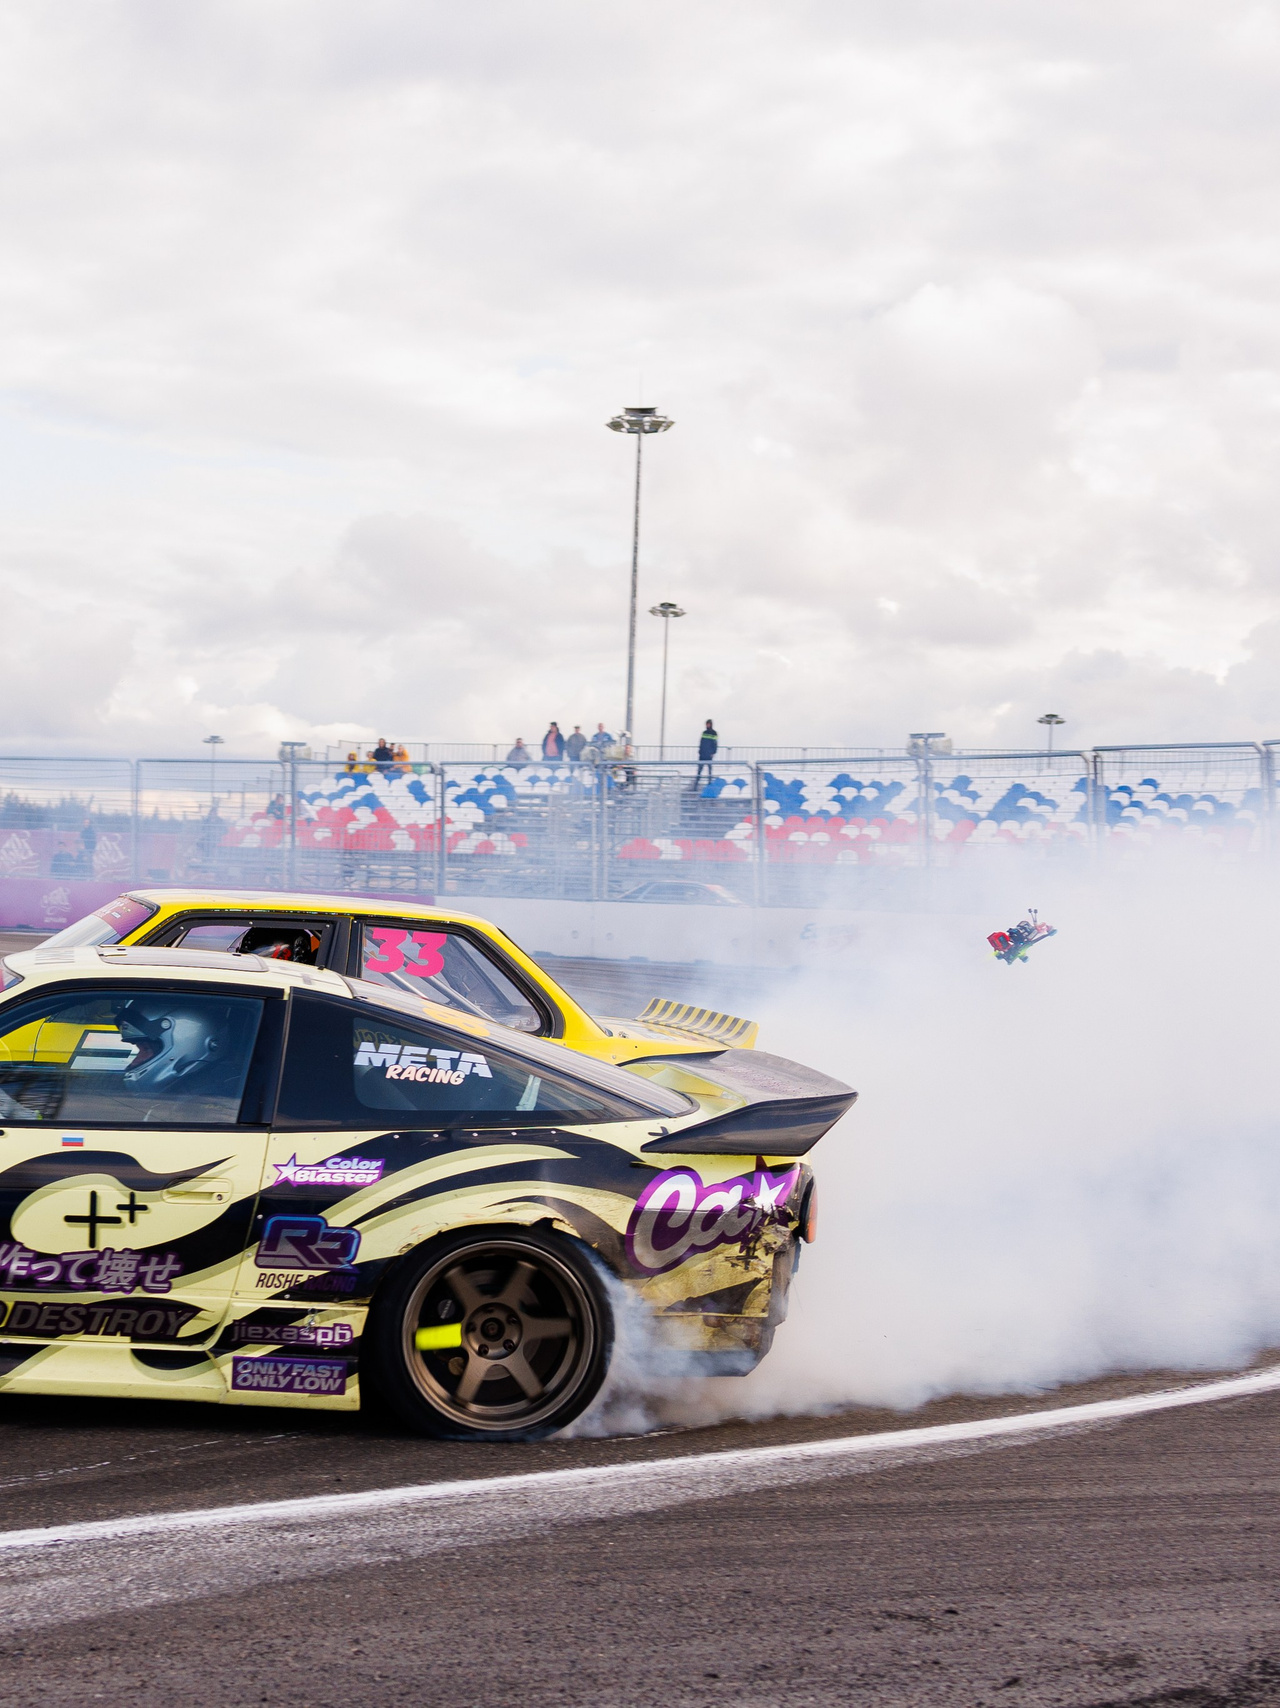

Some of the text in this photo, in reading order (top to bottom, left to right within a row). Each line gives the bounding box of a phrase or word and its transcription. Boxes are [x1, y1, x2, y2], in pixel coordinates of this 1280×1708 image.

[365, 927, 447, 977] 33
[354, 1042, 493, 1078] META
[385, 1064, 466, 1086] RACING
[325, 1157, 382, 1170] Color
[293, 1170, 380, 1184] Blaster
[255, 1272, 359, 1293] ROSHE RACING
[7, 1302, 194, 1337] DESTROY
[237, 1360, 344, 1378] ONLY FAST
[236, 1373, 343, 1391] ONLY LOW
